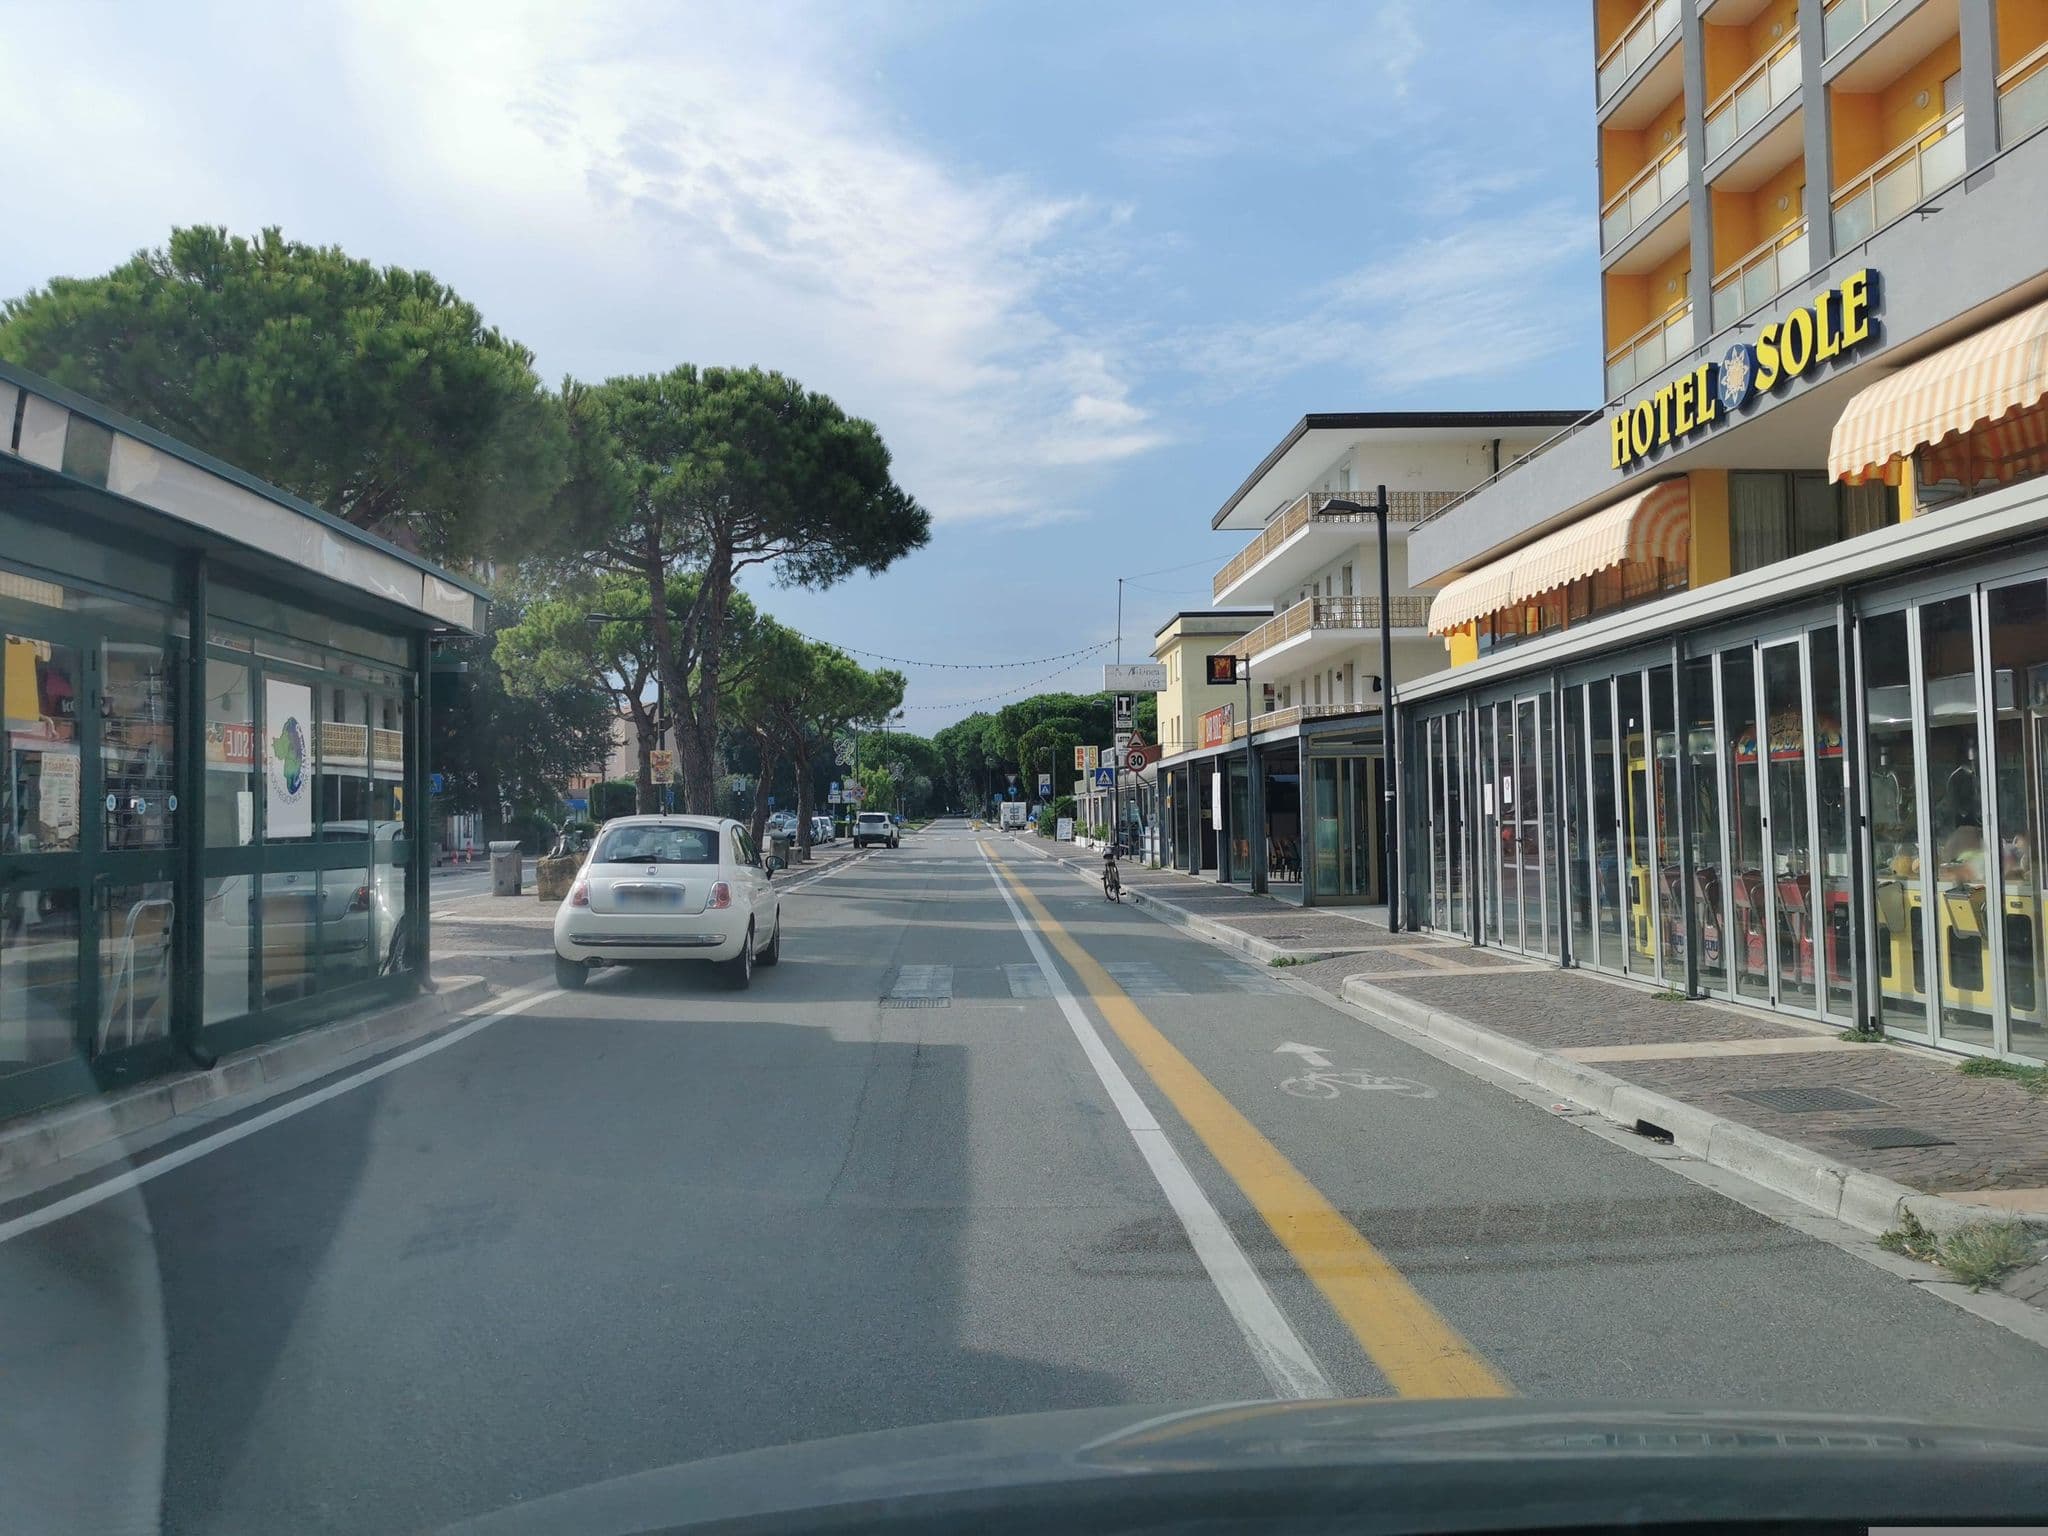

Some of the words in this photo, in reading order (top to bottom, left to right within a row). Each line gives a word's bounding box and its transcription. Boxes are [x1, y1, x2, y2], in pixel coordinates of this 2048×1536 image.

[1610, 362, 1718, 469] HOTEL
[1754, 268, 1880, 391] SOLE
[1130, 755, 1144, 766] 30
